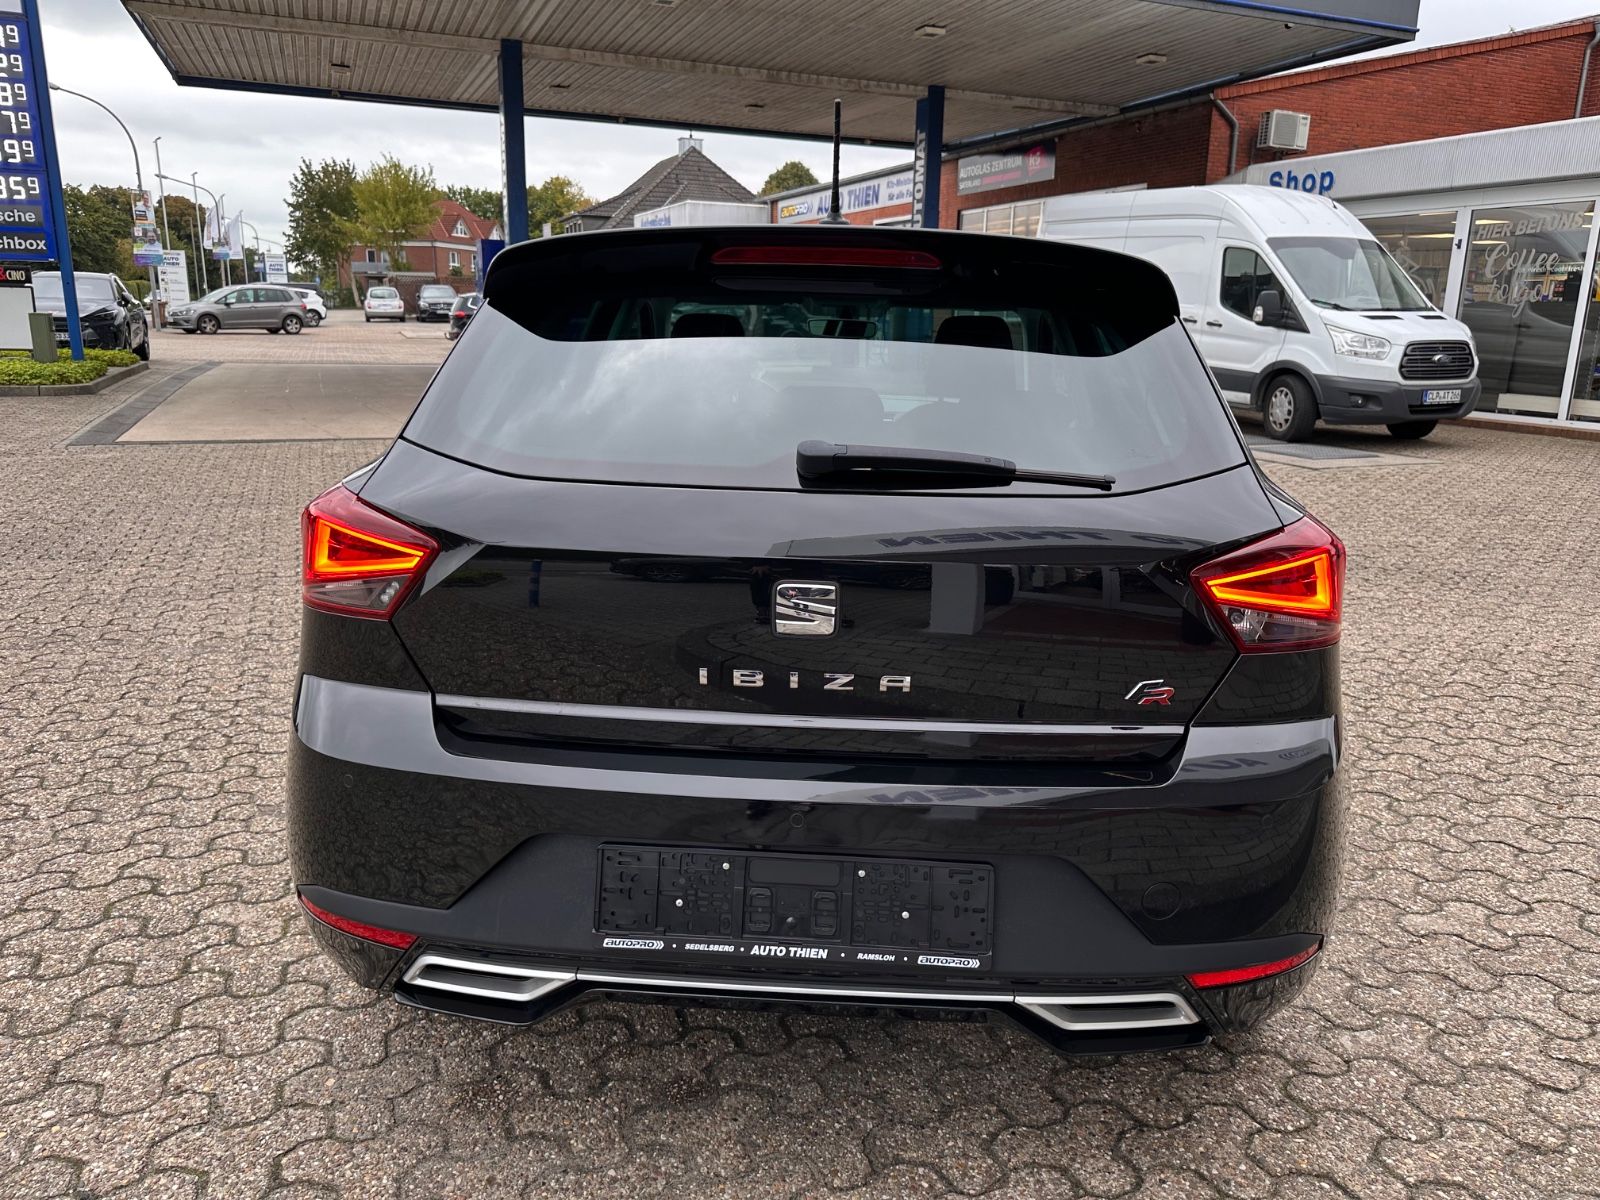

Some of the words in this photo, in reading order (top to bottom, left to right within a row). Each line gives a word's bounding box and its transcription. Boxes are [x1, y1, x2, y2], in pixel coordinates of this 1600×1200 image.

[960, 162, 991, 178] AUTOGLAS
[991, 155, 1023, 172] ZENTRUM
[1269, 170, 1334, 195] Shop
[817, 190, 844, 215] AUO
[847, 184, 880, 210] THIEN
[1477, 222, 1514, 240] HIER
[1515, 217, 1543, 236] BEI
[1544, 212, 1584, 231] UNS
[699, 667, 911, 692] IBIZA
[685, 943, 735, 952] SEDELSBERG
[750, 945, 786, 957] AUTO
[788, 947, 829, 959] THIEN
[857, 952, 896, 962] RAMSLOH
